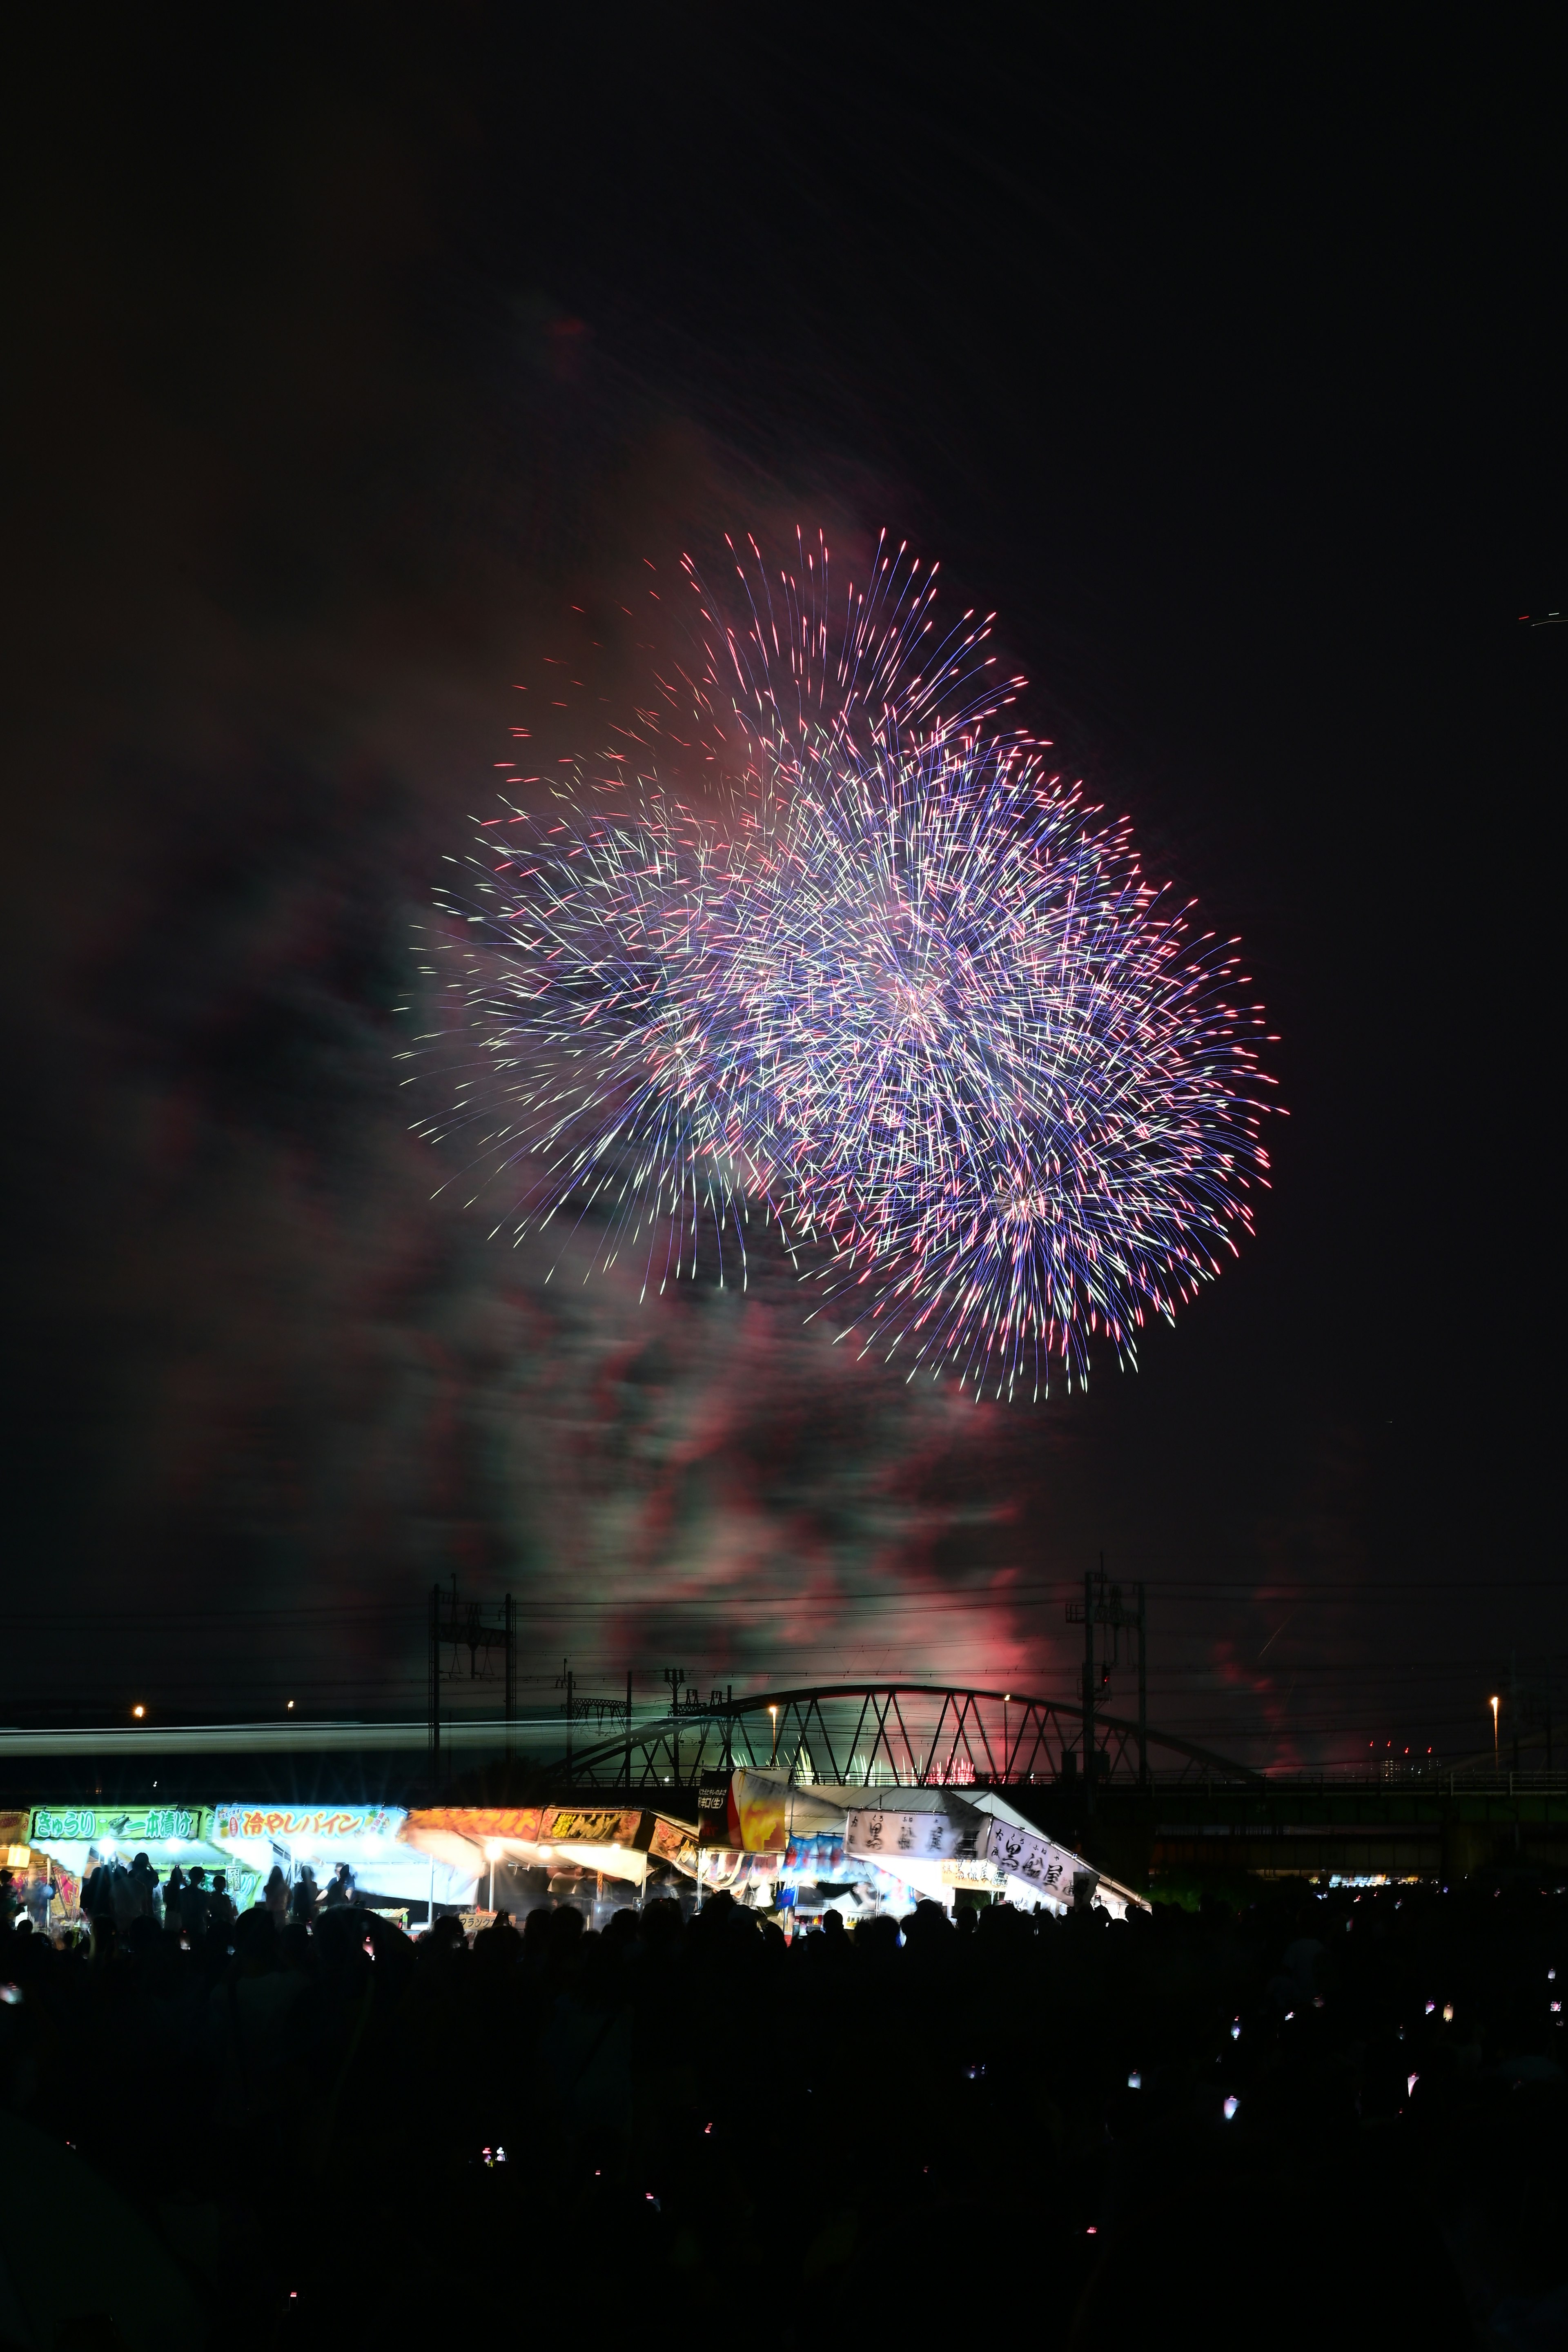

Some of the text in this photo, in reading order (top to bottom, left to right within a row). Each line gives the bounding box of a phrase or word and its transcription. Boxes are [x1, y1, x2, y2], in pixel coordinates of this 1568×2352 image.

[37, 1811, 95, 1837] きゅうり
[125, 1811, 191, 1837] 一本漬け
[243, 1812, 360, 1835] 冷やしパイン
[1001, 1840, 1063, 1891] 黒船屋
